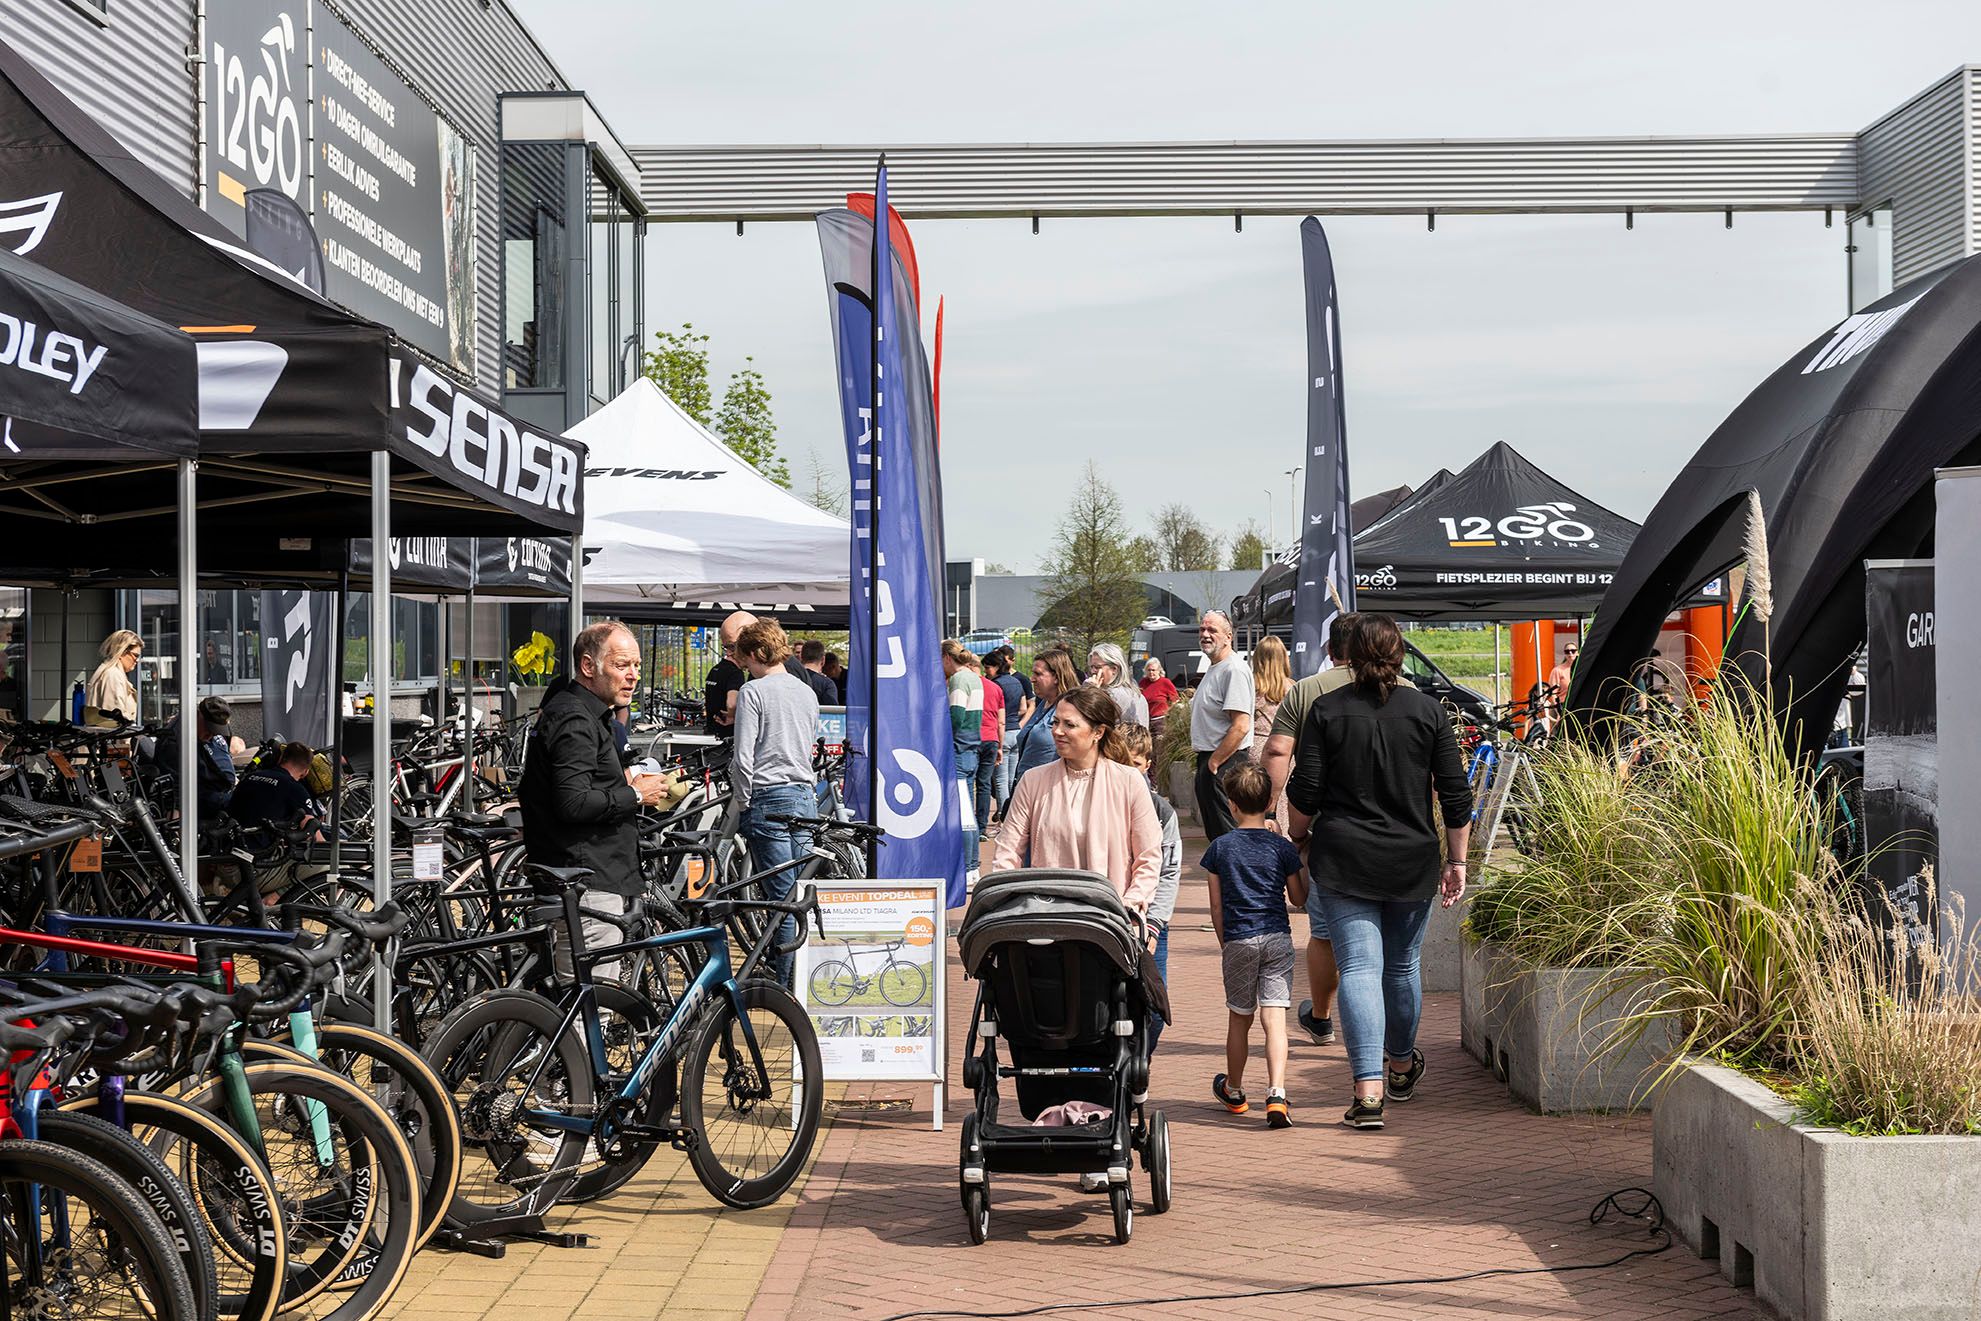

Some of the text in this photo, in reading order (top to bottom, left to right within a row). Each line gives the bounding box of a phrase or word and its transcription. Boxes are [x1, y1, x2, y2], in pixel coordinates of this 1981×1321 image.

[327, 48, 395, 128] DIRECT-MEE-SERVICE
[213, 42, 301, 201] 12GO
[328, 96, 336, 123] 10
[336, 103, 360, 144] DAGEN
[328, 143, 380, 202] EERLIJK ADVIES
[328, 190, 421, 274] PROFESSIONELE WERKPLAATS
[329, 238, 361, 279] KLANTEN
[361, 258, 403, 304] BEOORDELEN
[403, 285, 416, 312] ONS
[584, 468, 727, 480] EVENS
[1439, 513, 1595, 541] 12GO
[1501, 540, 1600, 549] BIKING
[1355, 572, 1397, 586] 12GO
[1436, 573, 1522, 583] FIETSPLEZIER
[1525, 573, 1573, 584] BEGINT
[1576, 574, 1596, 584] BIJ
[1907, 612, 1936, 648] GAR
[832, 892, 865, 902] EVENT
[867, 890, 917, 901] TOPDEAL
[137, 1175, 191, 1252] DT SWISS
[234, 1165, 277, 1257] DT SWISS
[338, 1166, 371, 1250] DT SWISS
